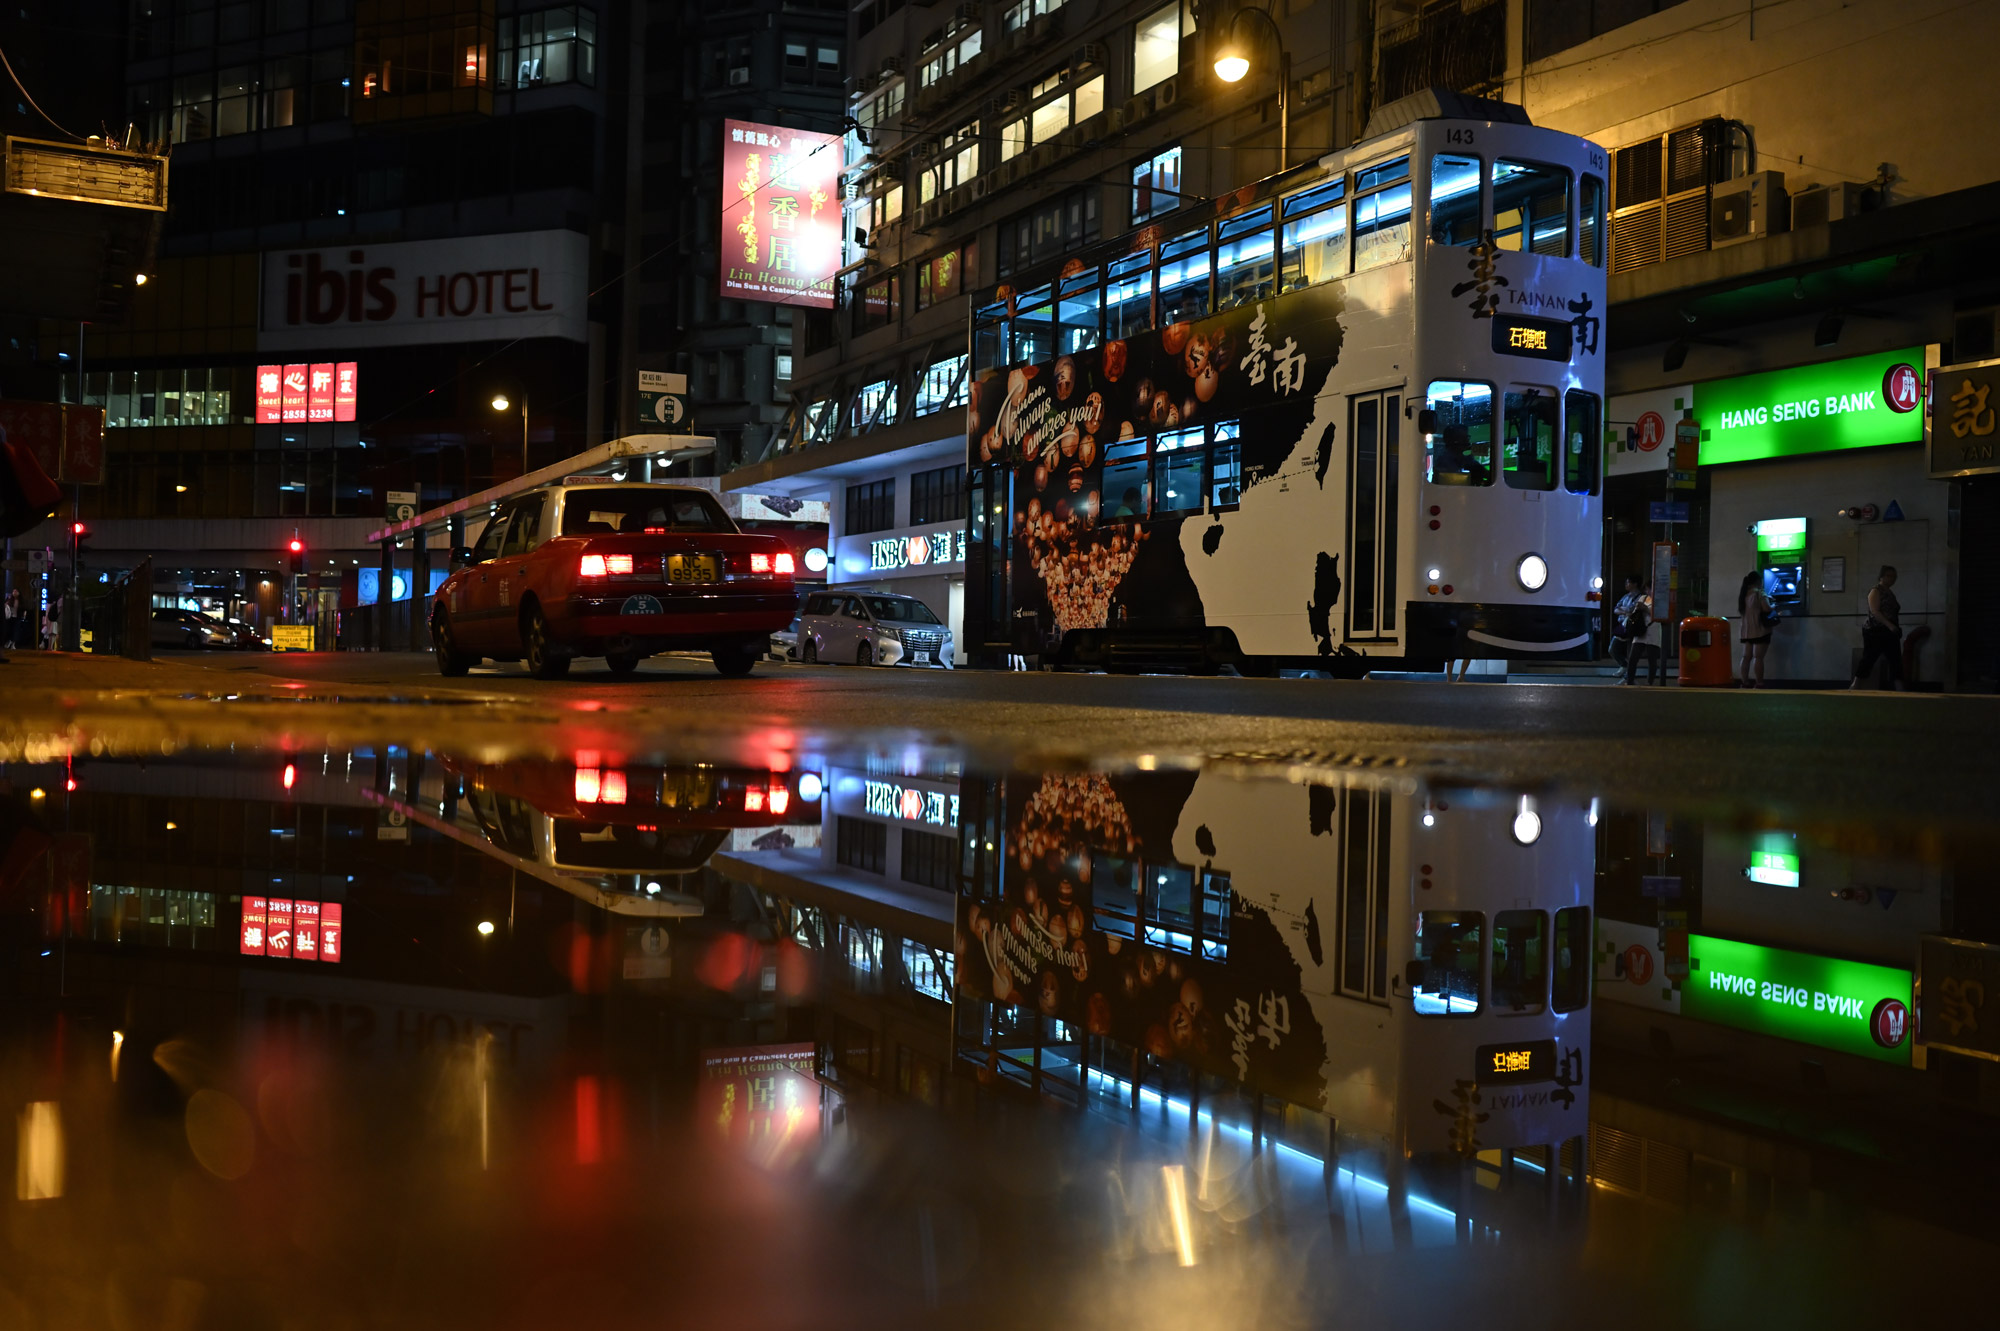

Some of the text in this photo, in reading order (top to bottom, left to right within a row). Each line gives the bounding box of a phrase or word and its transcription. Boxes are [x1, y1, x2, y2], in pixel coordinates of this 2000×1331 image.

[1447, 128, 1473, 144] 143
[1590, 151, 1603, 169] 143
[768, 152, 800, 272] 蓮香居
[287, 250, 553, 325] ibis HOTEL
[727, 280, 742, 288] Dim
[744, 282, 760, 290] Sum
[769, 285, 807, 296] Cantonese
[730, 268, 834, 291] Lin Heung Kui
[1508, 290, 1565, 310] TAINAN
[1568, 292, 1600, 355] 南
[1509, 327, 1547, 349] 石塘咀
[1240, 303, 1307, 397] 臺南
[260, 371, 331, 393] 糖心軒
[340, 371, 352, 393] 酒家
[258, 396, 281, 405] Sweet
[283, 396, 304, 404] heart
[1721, 391, 1876, 429] HANG SENG BANK
[1951, 378, 1995, 438] 記
[283, 410, 305, 419] 2858
[309, 409, 332, 418] 3238
[1014, 397, 1052, 445] always
[1027, 410, 1067, 455] amazes
[1961, 445, 1992, 460] YAN
[683, 557, 701, 568] NC
[870, 537, 909, 570] HSBC
[674, 569, 711, 580] 9935
[638, 601, 646, 609] 5
